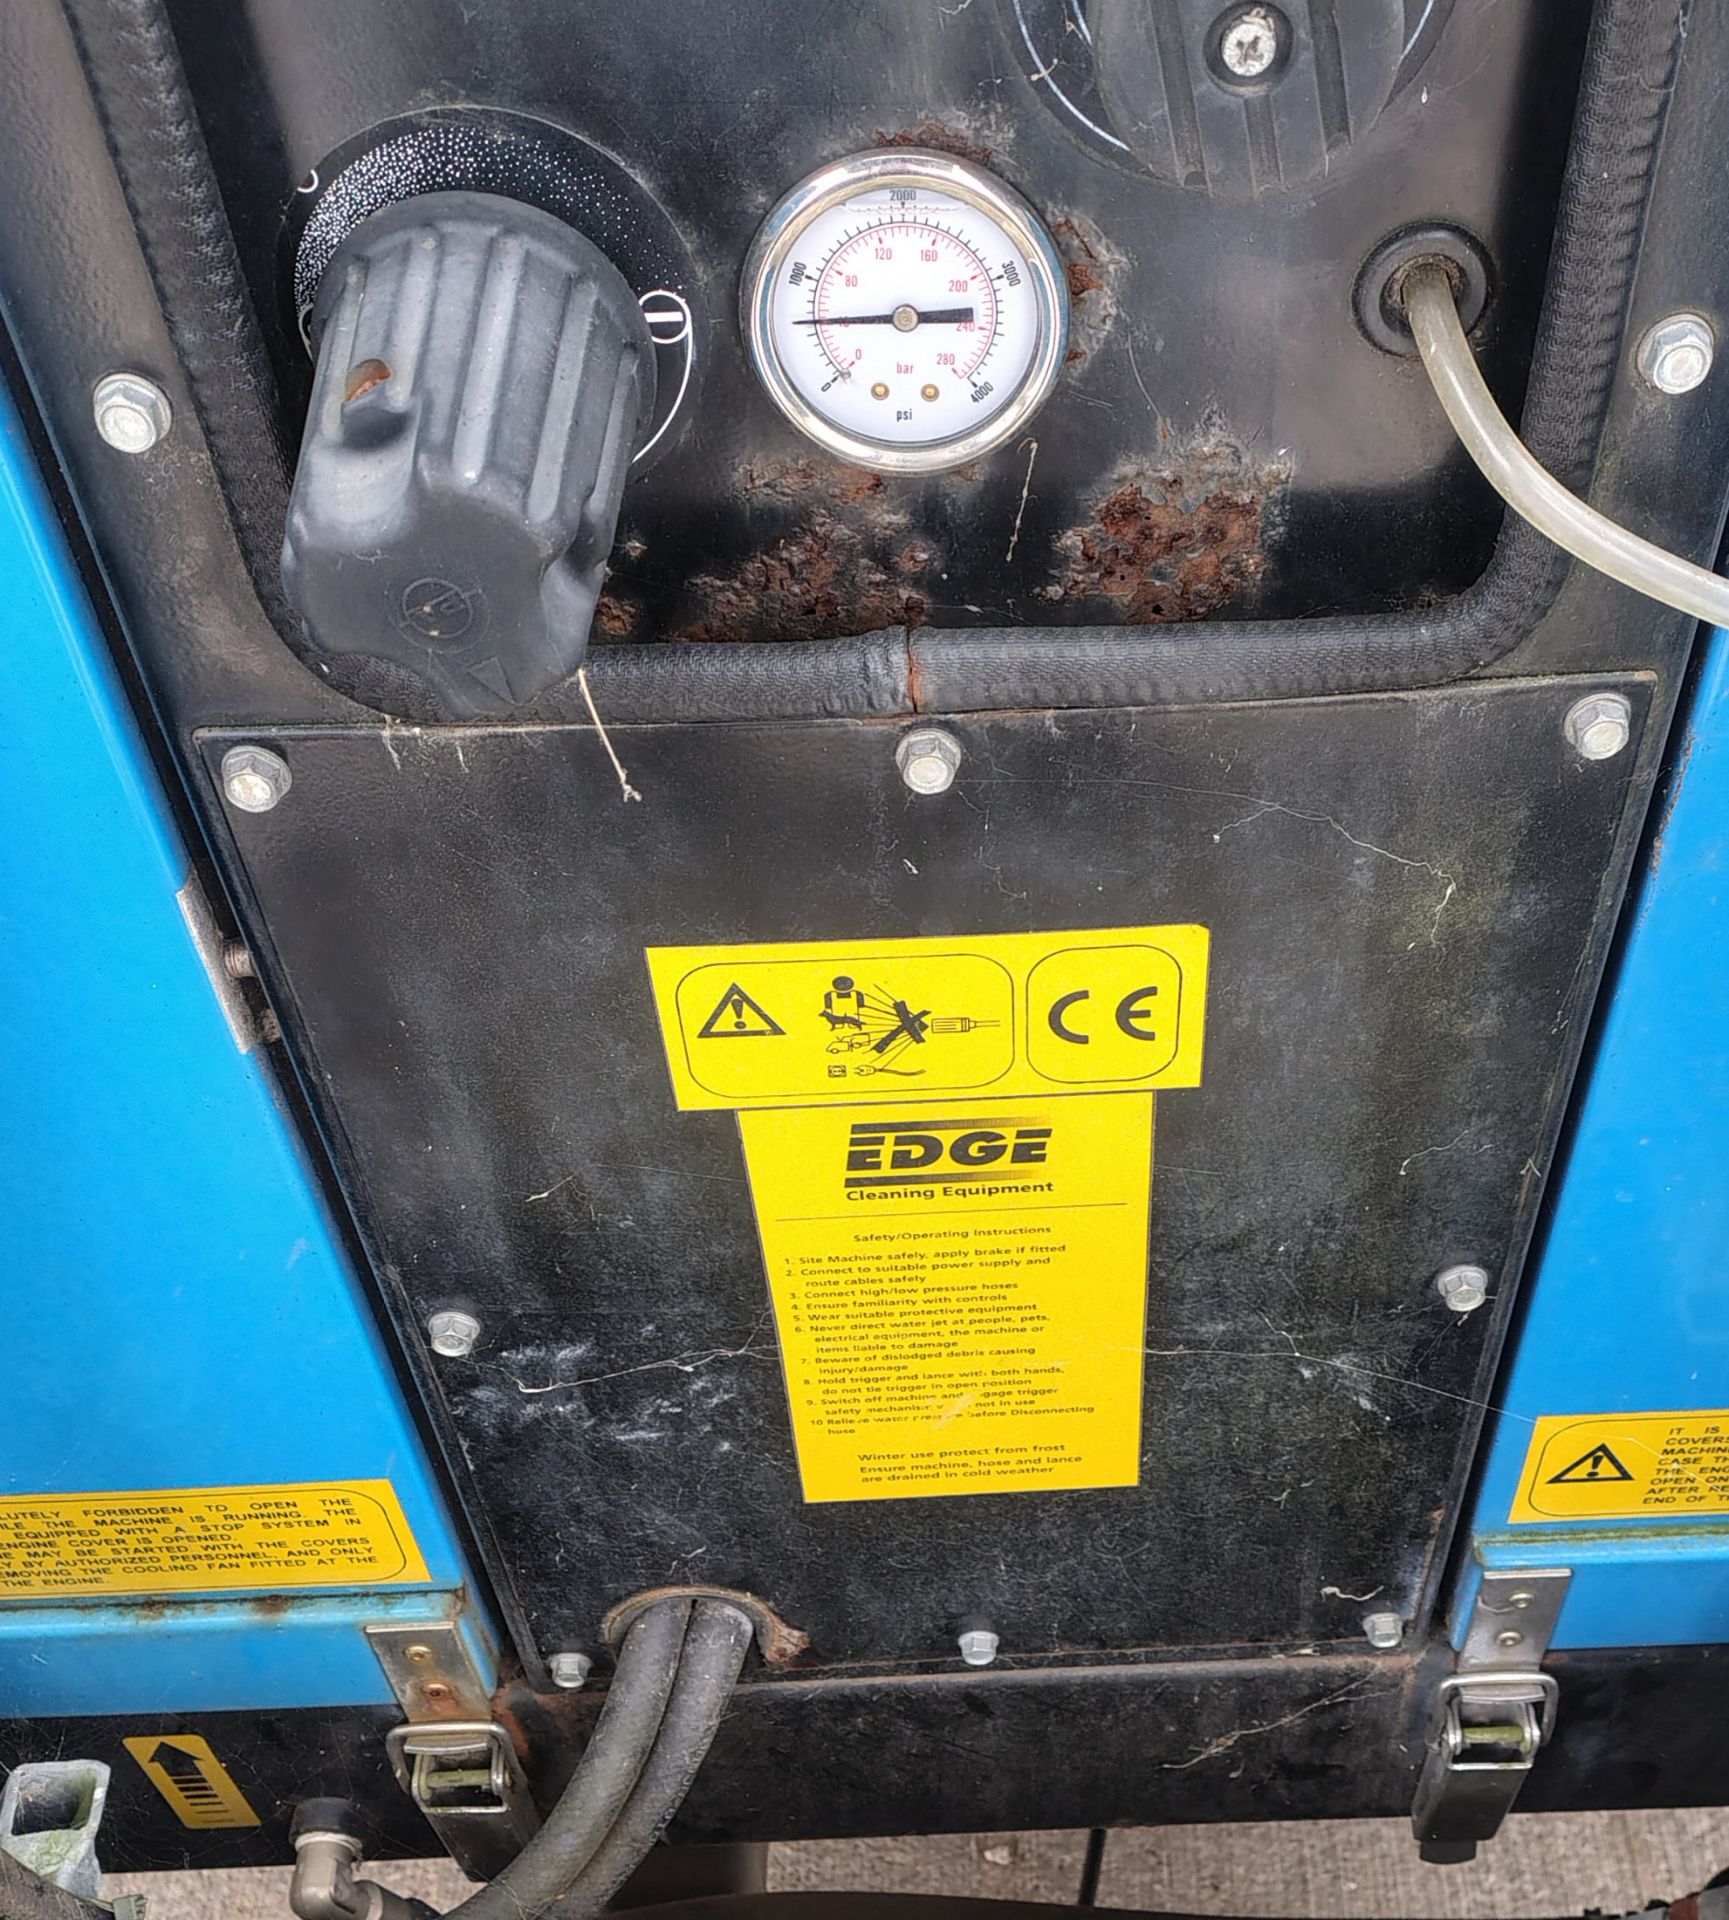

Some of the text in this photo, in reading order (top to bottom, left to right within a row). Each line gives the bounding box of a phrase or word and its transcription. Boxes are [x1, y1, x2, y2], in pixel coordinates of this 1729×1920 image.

[889, 190, 916, 200] 2000
[874, 248, 892, 260] 120
[920, 250, 938, 262] 160
[788, 262, 807, 286] 1000
[1001, 260, 1021, 286] 3000
[845, 276, 858, 287] 80
[948, 280, 968, 292] 200
[855, 349, 862, 360] 0
[936, 354, 955, 366] 280
[896, 362, 914, 374] bar
[970, 381, 994, 404] 4000
[896, 409, 912, 421] psi
[845, 1128, 1053, 1172] EDGE
[846, 1181, 1053, 1201] Cleaning Equipment
[854, 1226, 1051, 1242] Safety/Operating Instructions
[799, 1256, 823, 1264] Site
[828, 1253, 883, 1263] Machine
[933, 1249, 969, 1259] apply
[974, 1247, 1011, 1256] brake
[1016, 1246, 1025, 1254] if
[1030, 1244, 1066, 1253] fitted
[801, 1256, 1050, 1276] Connect to suitable power supply and
[806, 1274, 926, 1287] route cables safely
[804, 1289, 856, 1298] Connect
[860, 1287, 918, 1297] high/low
[923, 1285, 977, 1295] pressure
[852, 1297, 917, 1307] familiarity
[922, 1296, 951, 1304] with
[956, 1293, 1007, 1302] controls
[845, 1310, 894, 1319] suitable
[899, 1307, 963, 1318] protective
[968, 1303, 1037, 1315] equipment
[810, 1324, 845, 1332] Never
[850, 1321, 885, 1330] direct
[890, 1320, 926, 1328] water
[931, 1318, 947, 1328] jet
[952, 1317, 964, 1325] at
[814, 1333, 869, 1343] electrical
[949, 1328, 970, 1336] the
[974, 1326, 1027, 1335] machine
[816, 1341, 958, 1353] items to damage
[815, 1356, 860, 1364] Beware
[881, 1351, 942, 1361] dislodged
[946, 1349, 984, 1358] debris
[989, 1347, 1035, 1356] causing
[818, 1376, 846, 1384] Hold
[850, 1375, 891, 1384] trigger
[896, 1373, 918, 1381] and
[923, 1372, 954, 1380] lance
[991, 1368, 1020, 1376] both
[819, 1364, 908, 1375] injury/damage
[822, 1387, 838, 1395] do
[842, 1385, 862, 1394] not
[886, 1383, 927, 1392] trigger
[947, 1381, 978, 1390] open
[821, 1395, 882, 1405] Switch off
[825, 1406, 861, 1415] safety
[975, 1400, 995, 1408] not
[1011, 1405, 1094, 1416] Disconnecting
[1669, 1426, 1720, 1435] IT IS
[858, 1452, 905, 1461] Winter
[939, 1447, 989, 1459] protect
[1033, 1444, 1065, 1452] frost
[860, 1465, 906, 1473] Ensure
[1016, 1457, 1041, 1466] and
[1658, 1457, 1703, 1466] CASE
[887, 1471, 940, 1481] drained
[963, 1469, 991, 1477] cold
[996, 1466, 1054, 1475] weather
[1650, 1477, 1696, 1486] OPEN
[1645, 1486, 1699, 1496] AFTER
[1643, 1495, 1707, 1504] END OF
[82, 1497, 352, 1517] FORBIDDEN TO OPEN THE
[41, 1518, 77, 1528] THE
[93, 1515, 173, 1526] MACHINE
[189, 1513, 206, 1522] IS
[324, 1507, 356, 1516] THE
[13, 1517, 361, 1539] EQUIPPED WITH A STOP SYSTEM IN
[26, 1536, 370, 1558] MAY BE STARTED WITH THE COVERS
[68, 1537, 128, 1547] COVER
[136, 1536, 152, 1545] IS
[21, 1559, 43, 1568] BY
[55, 1554, 161, 1567] AUTHORIZED
[287, 1548, 320, 1557] AND
[330, 1546, 372, 1555] ONLY
[79, 1555, 378, 1575] THE COOLING FAN FITTED AT THE
